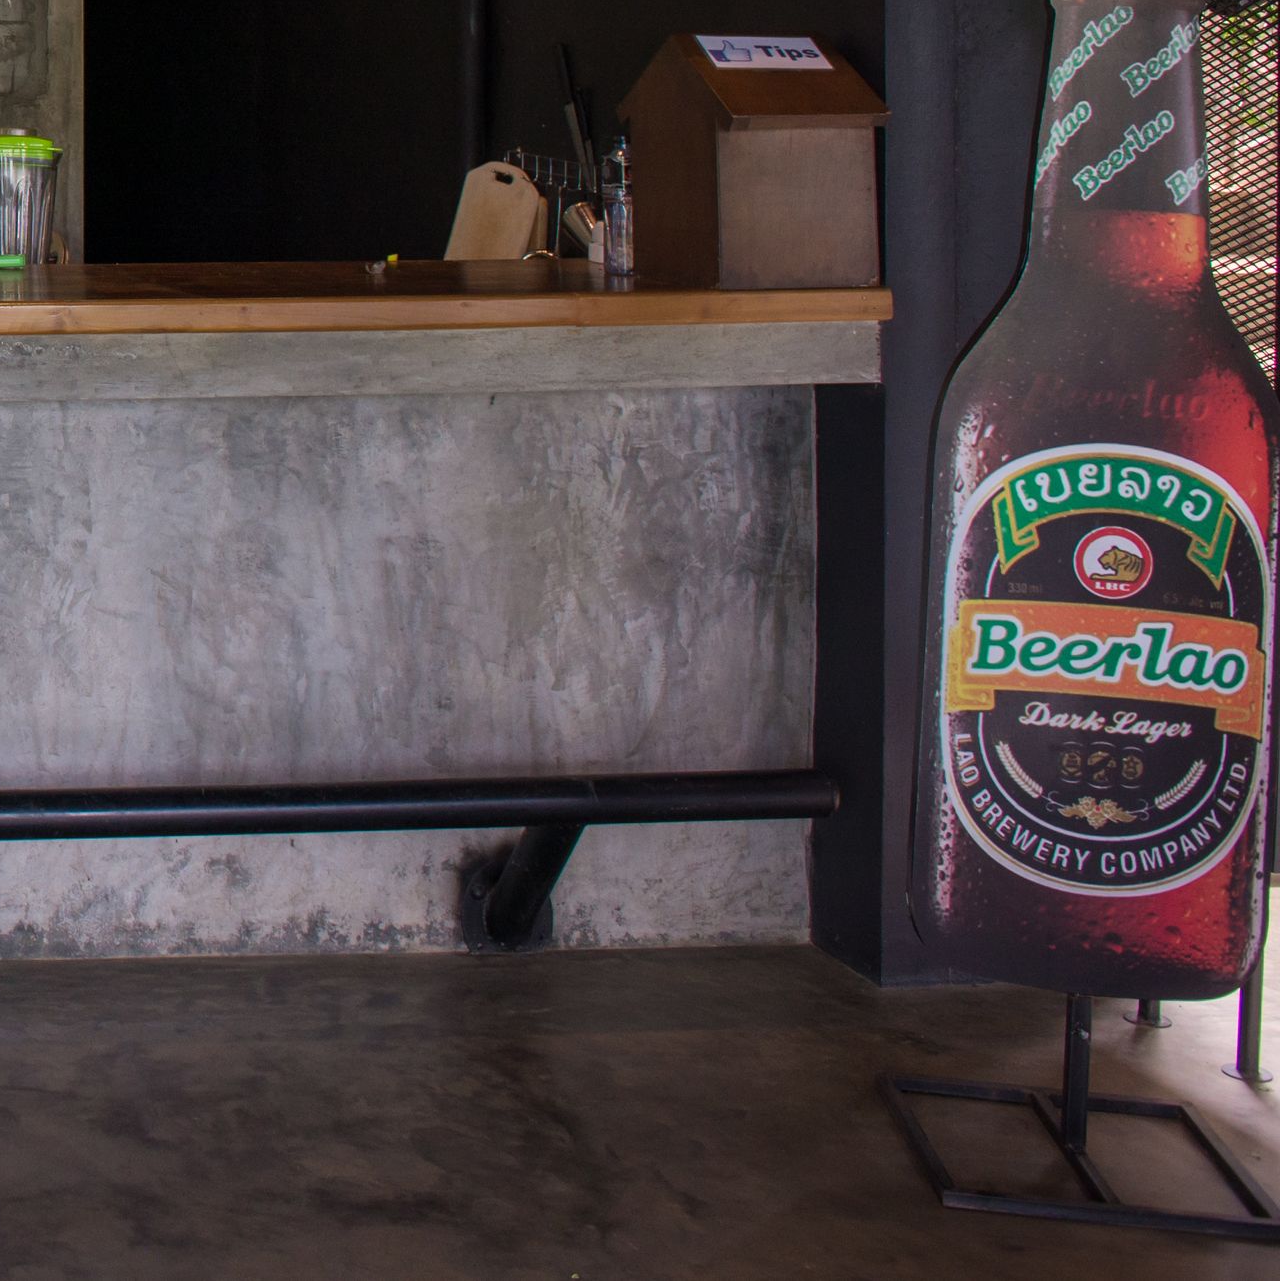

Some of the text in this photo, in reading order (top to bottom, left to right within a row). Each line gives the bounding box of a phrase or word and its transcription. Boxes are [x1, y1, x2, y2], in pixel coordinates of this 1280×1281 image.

[754, 44, 820, 61] Tips
[1049, 5, 1134, 102] Beerlao
[1072, 109, 1175, 201] Beerlao
[1094, 581, 1131, 593] LBC
[971, 615, 1248, 694] Beerlao
[1019, 701, 1193, 744] Dark Lager
[953, 732, 981, 788] LAO
[971, 788, 1091, 872] BREWERY
[1099, 809, 1223, 876] COMPANY
